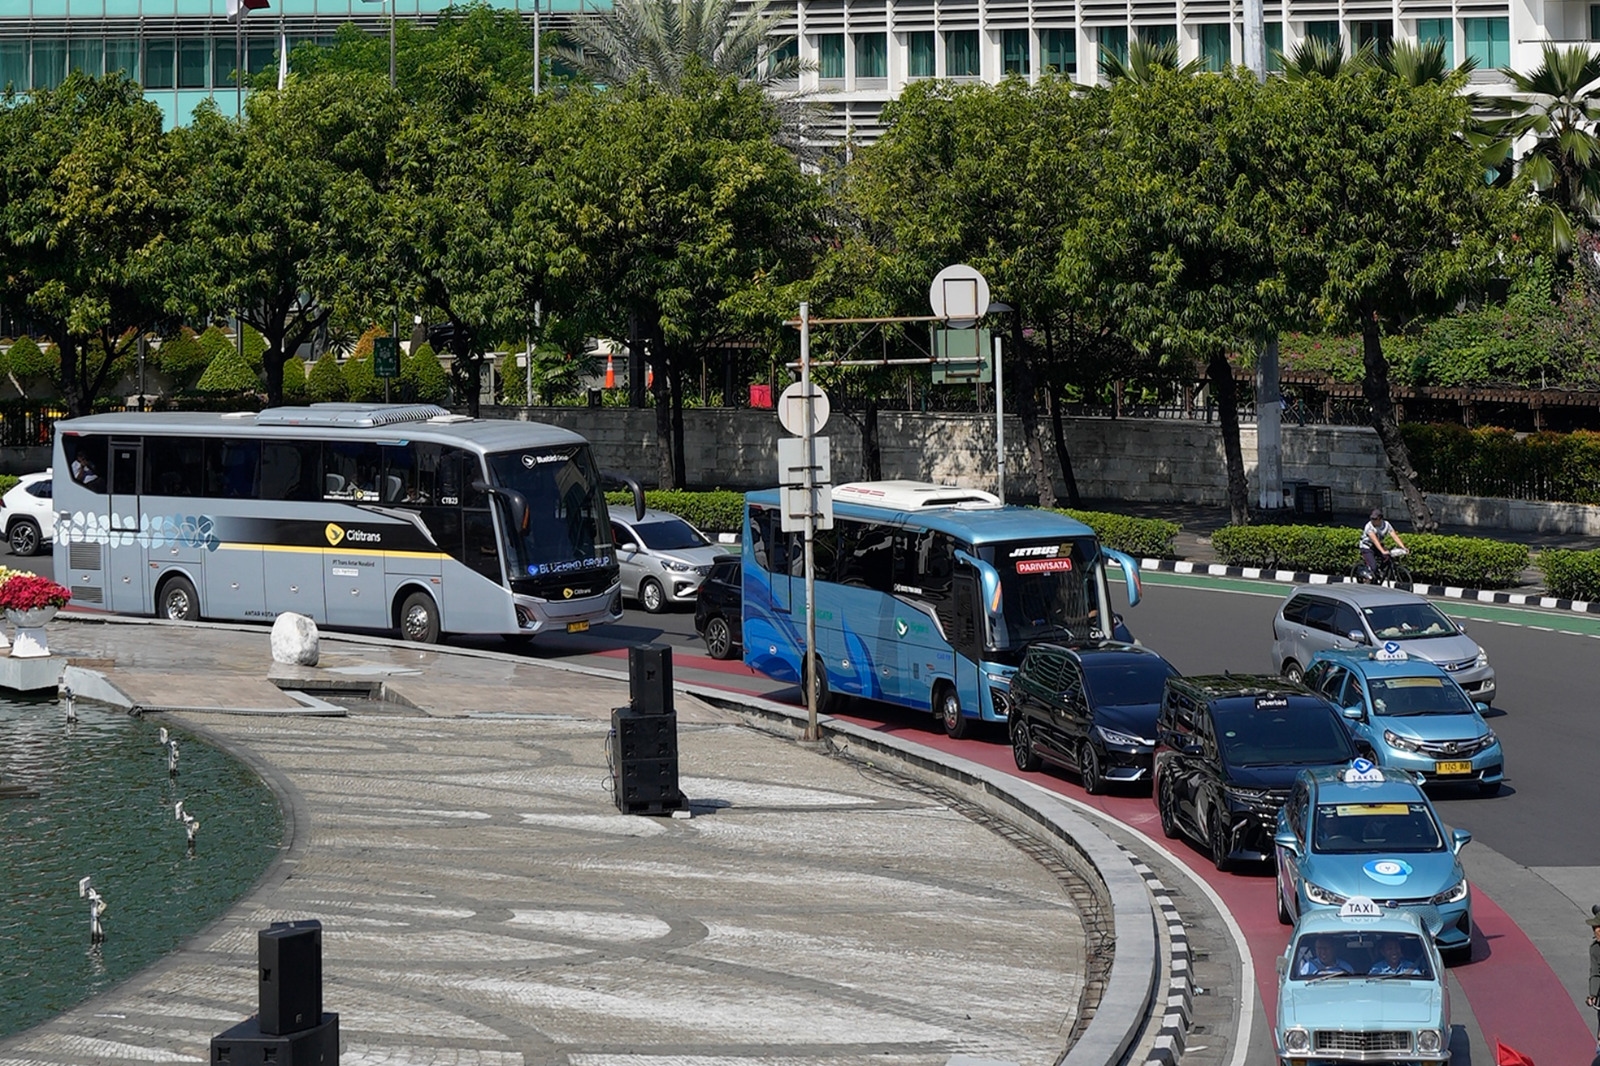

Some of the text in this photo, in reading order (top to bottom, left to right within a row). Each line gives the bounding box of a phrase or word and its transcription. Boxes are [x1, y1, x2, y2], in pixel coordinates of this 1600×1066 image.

[346, 529, 381, 542] Cititrans
[1009, 545, 1060, 557] JETBUS
[1058, 542, 1074, 557] 5
[1019, 561, 1069, 572] PARIWISATA
[1348, 904, 1374, 913] TAXI
